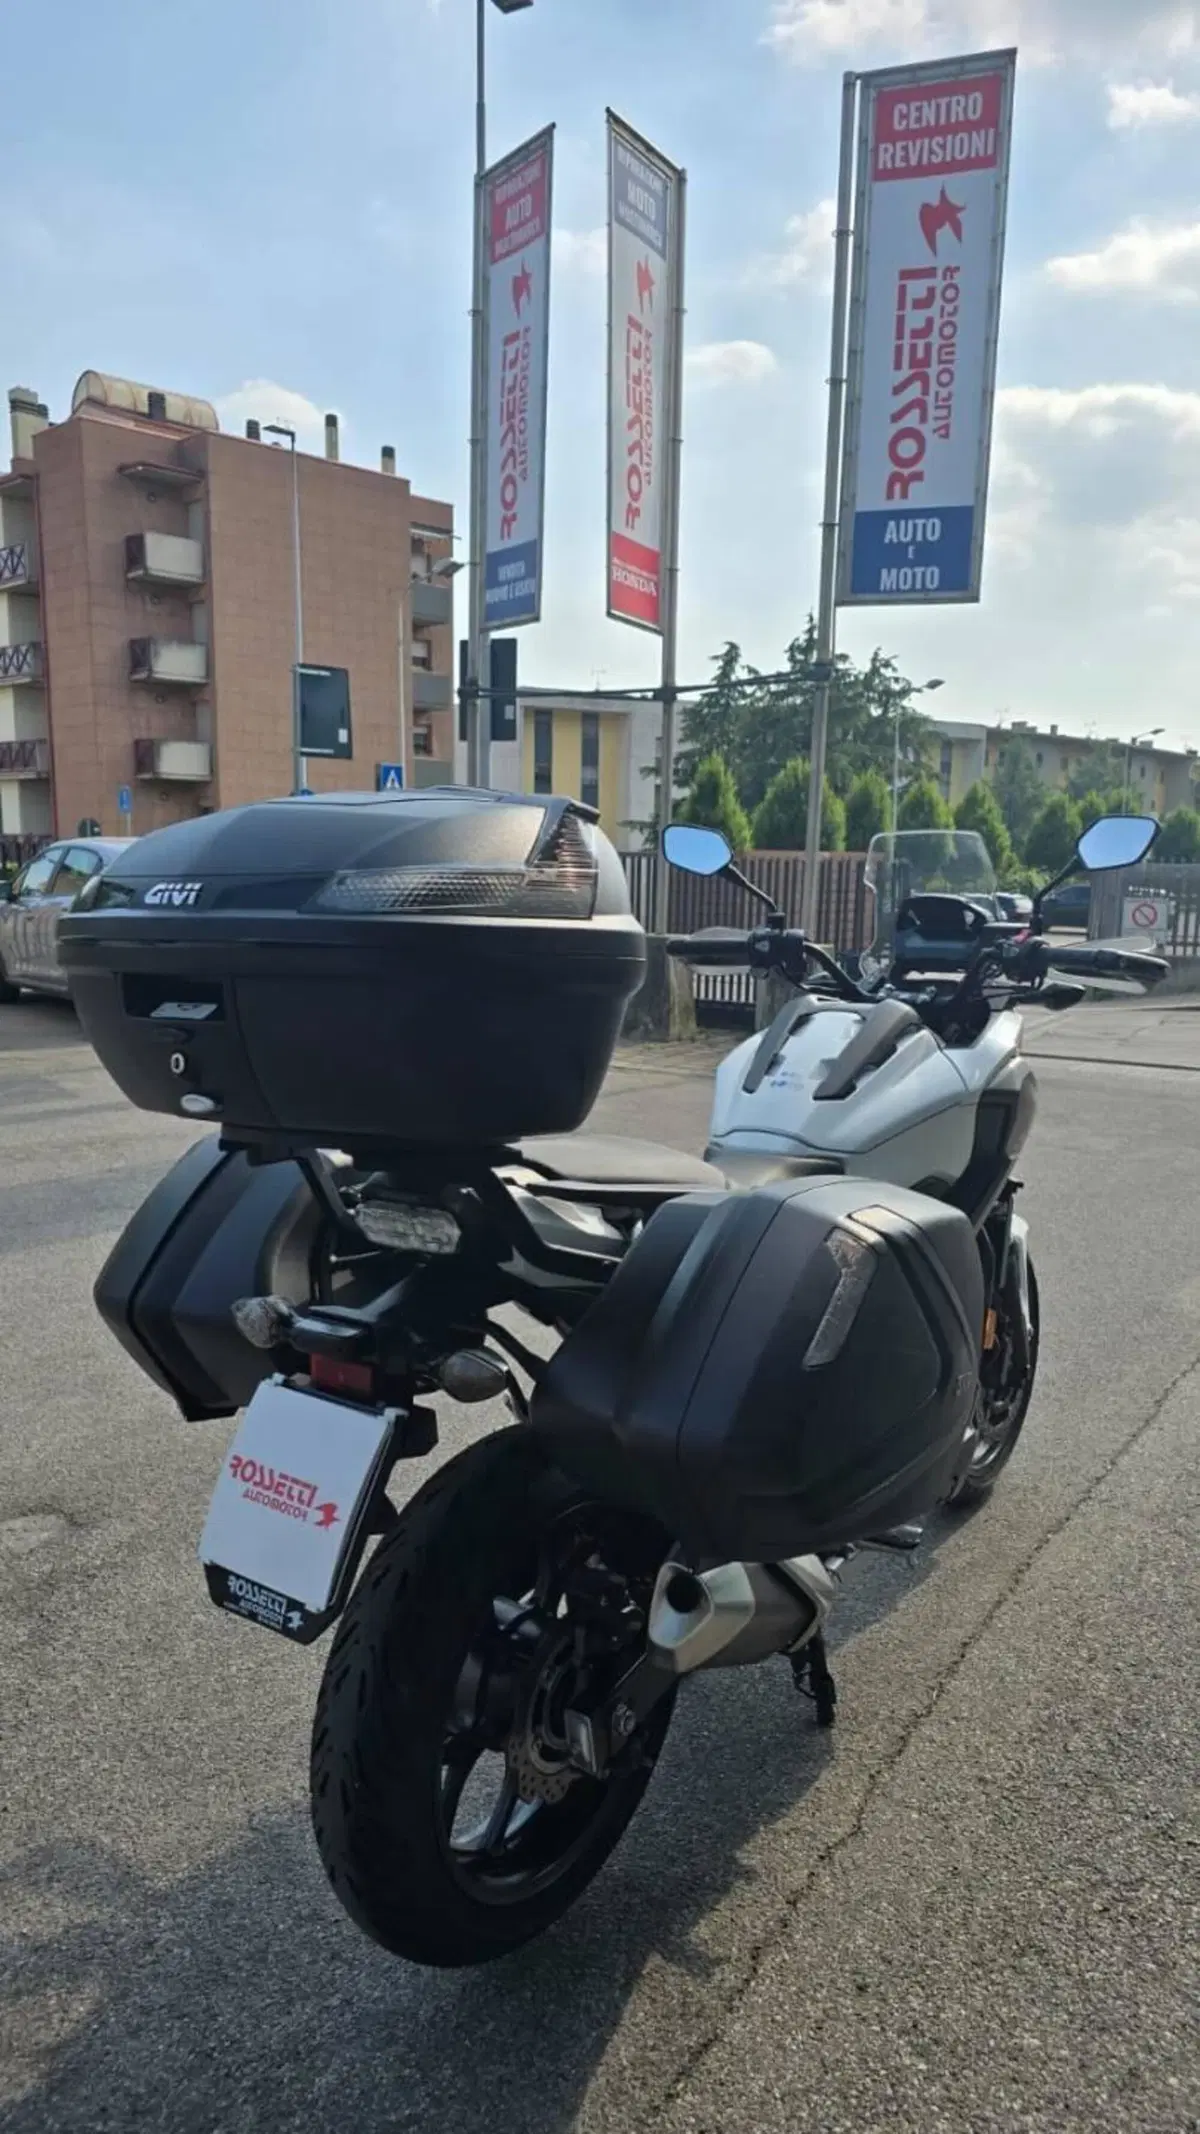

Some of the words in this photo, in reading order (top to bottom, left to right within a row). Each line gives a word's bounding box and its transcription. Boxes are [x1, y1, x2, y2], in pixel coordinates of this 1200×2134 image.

[892, 92, 983, 131] CENTRO
[877, 128, 996, 169] REVISIONI
[932, 265, 961, 440] AUTOMOTOR
[886, 266, 938, 501] ROSSETTI
[883, 517, 942, 544] AUTO
[907, 544, 916, 559] E
[612, 565, 657, 597] HONDA
[880, 564, 940, 592] MOTO
[144, 882, 203, 906] GIVI
[229, 1454, 319, 1508] ROSSETTI
[227, 1574, 287, 1616] ROSSETTI
